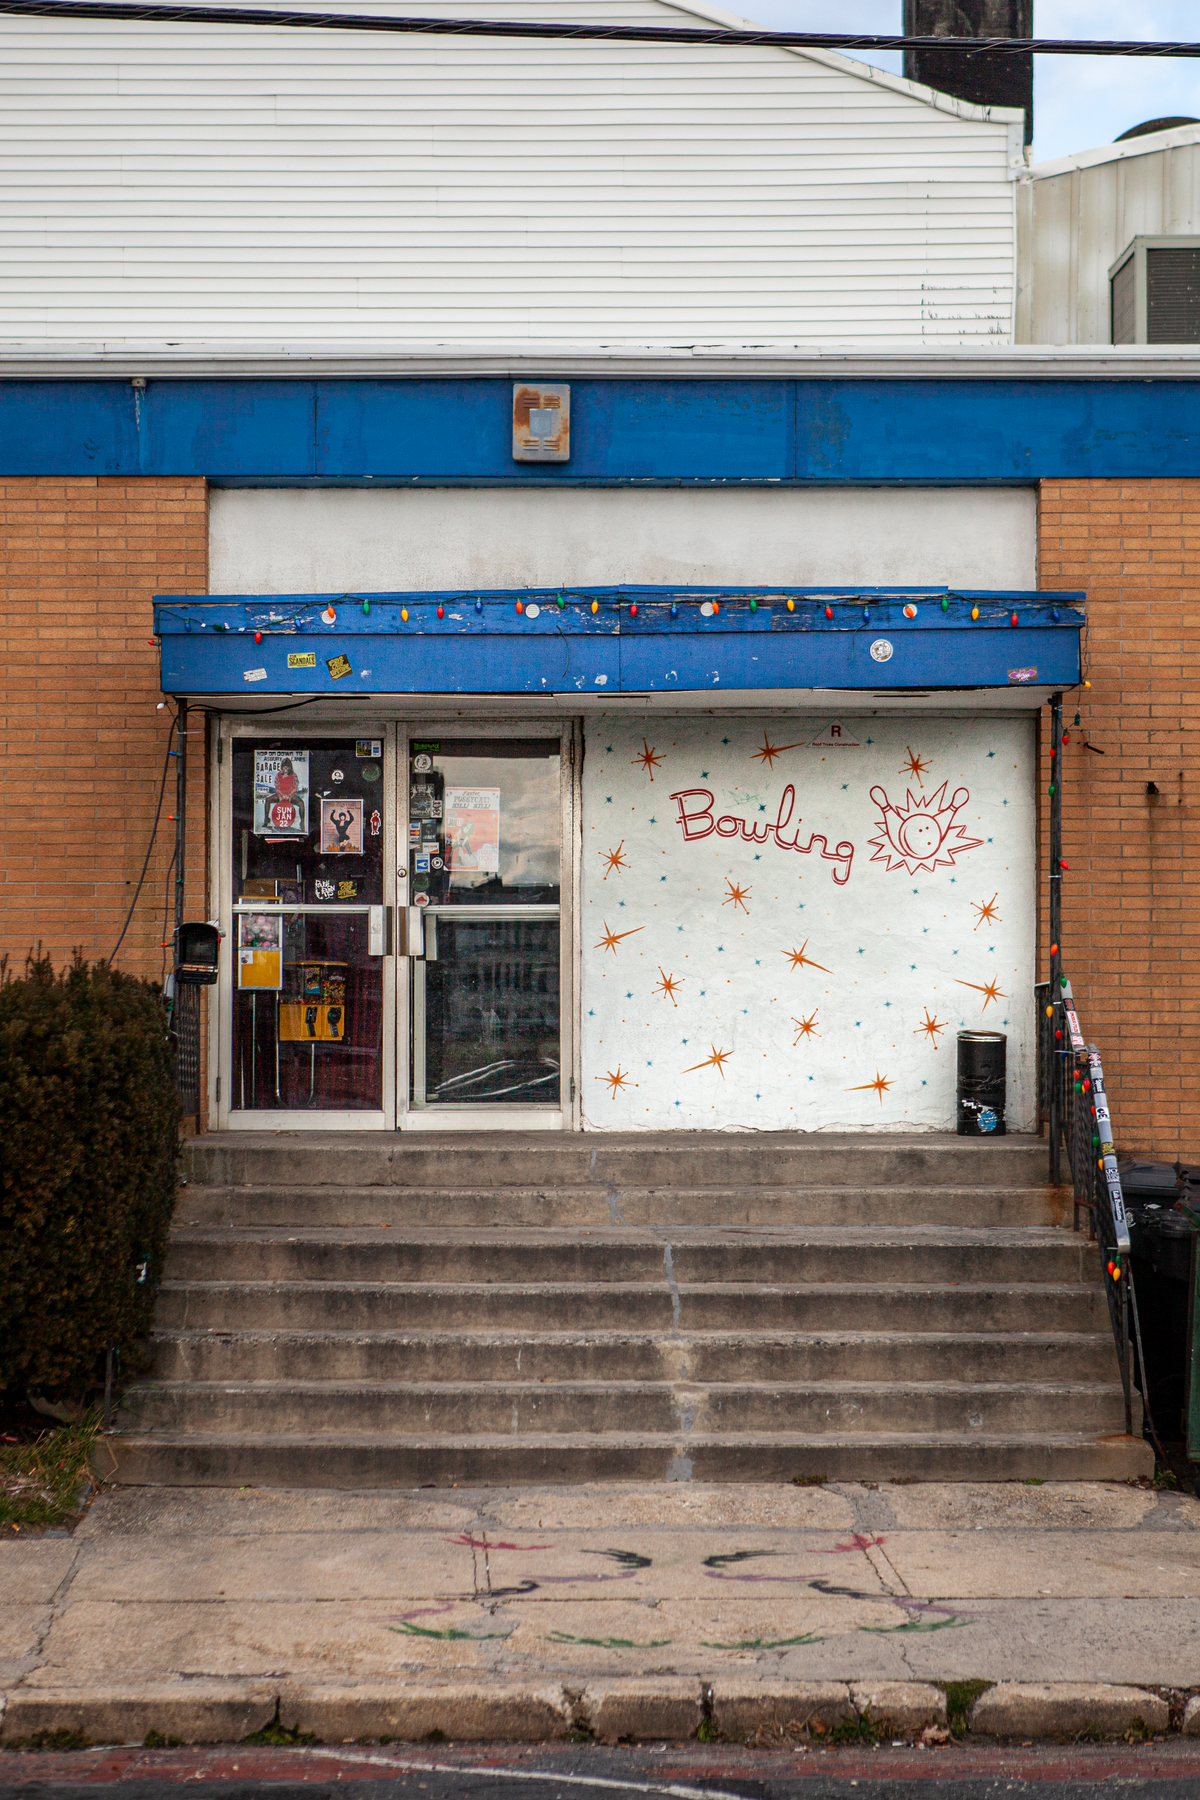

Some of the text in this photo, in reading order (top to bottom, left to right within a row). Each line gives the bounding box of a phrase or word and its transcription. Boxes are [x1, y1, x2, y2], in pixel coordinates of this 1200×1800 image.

[289, 657, 314, 666] SCANDALS
[831, 725, 842, 737] R
[256, 761, 281, 772] GARAGE
[256, 773, 272, 783] SALE
[276, 806, 292, 814] SUN
[275, 813, 292, 821] JAN
[669, 783, 854, 885] Bowling
